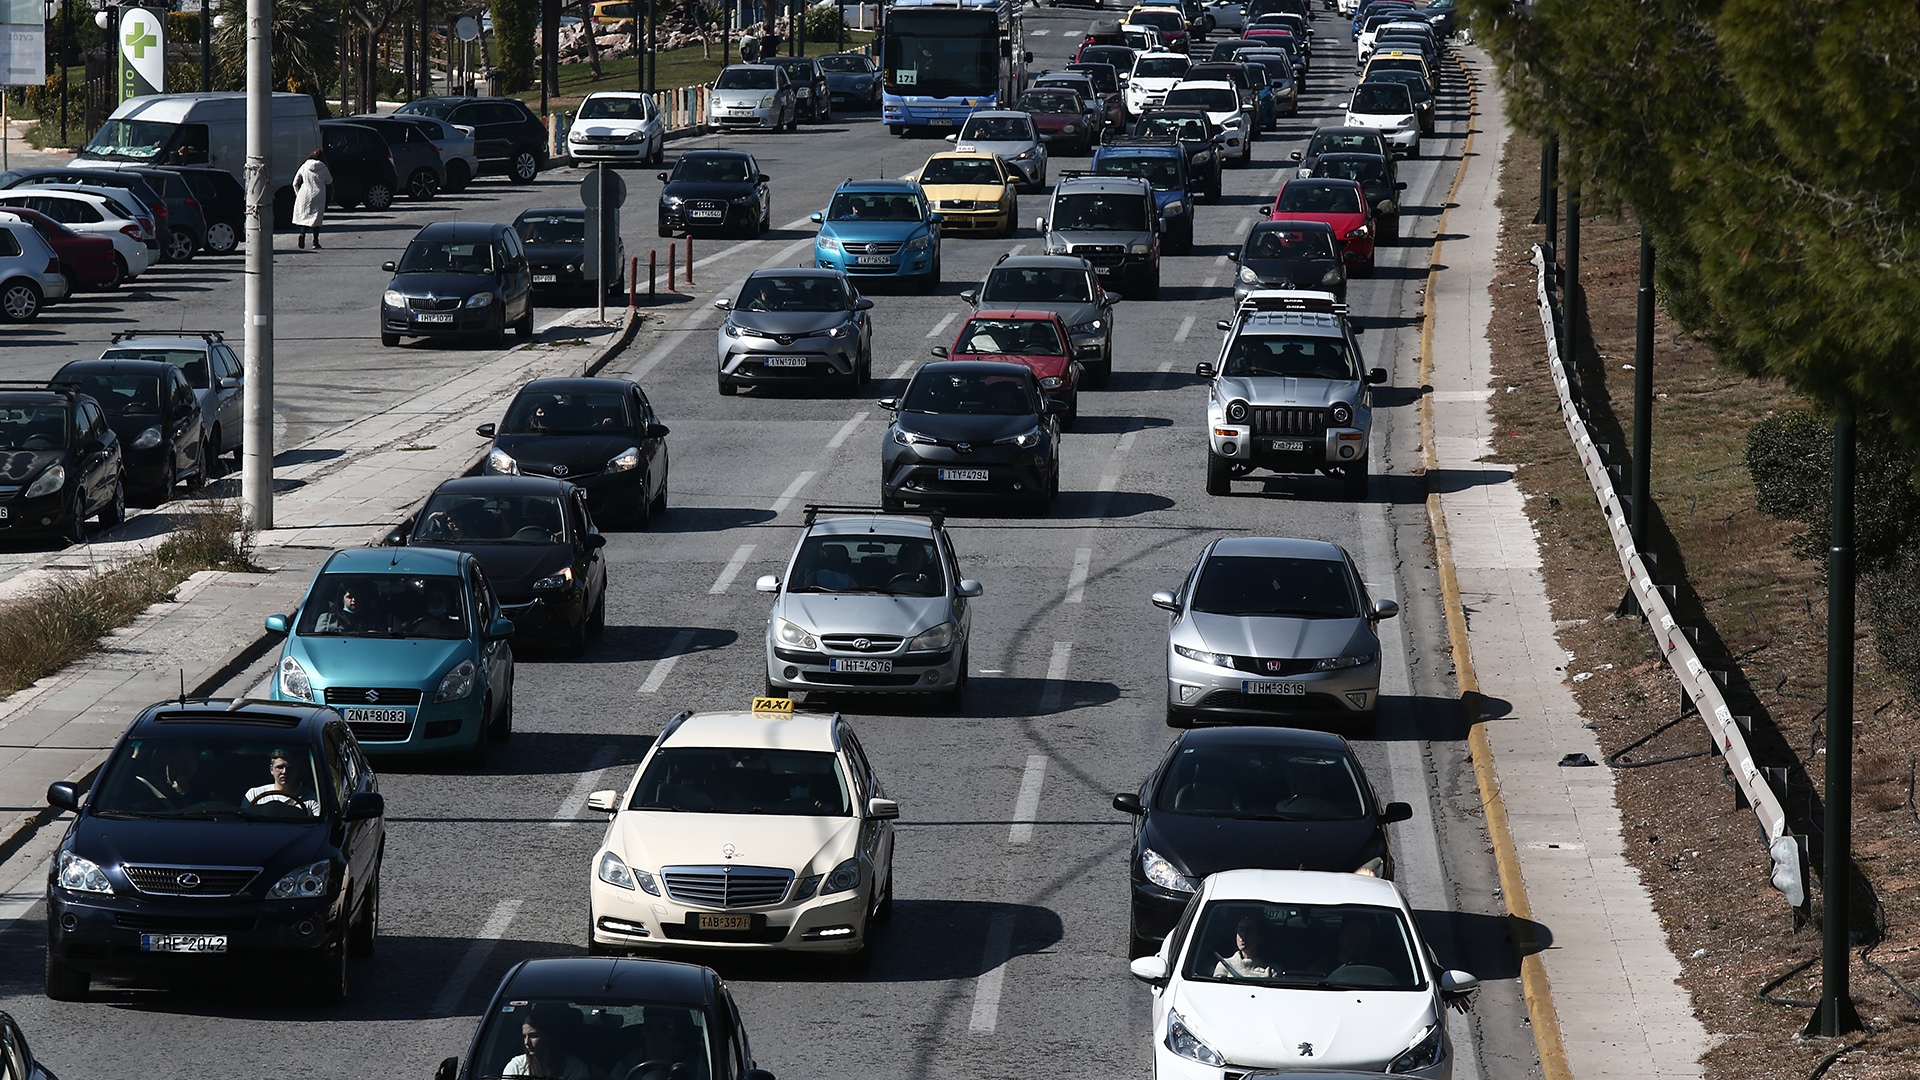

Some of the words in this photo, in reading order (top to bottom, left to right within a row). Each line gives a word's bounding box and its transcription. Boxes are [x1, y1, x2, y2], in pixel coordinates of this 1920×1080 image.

[898, 74, 915, 83] 171
[841, 660, 891, 672] IHT-4976
[1253, 682, 1305, 694] IHM-3619
[755, 699, 791, 710] TAXI
[346, 709, 405, 722] ZNA-8083
